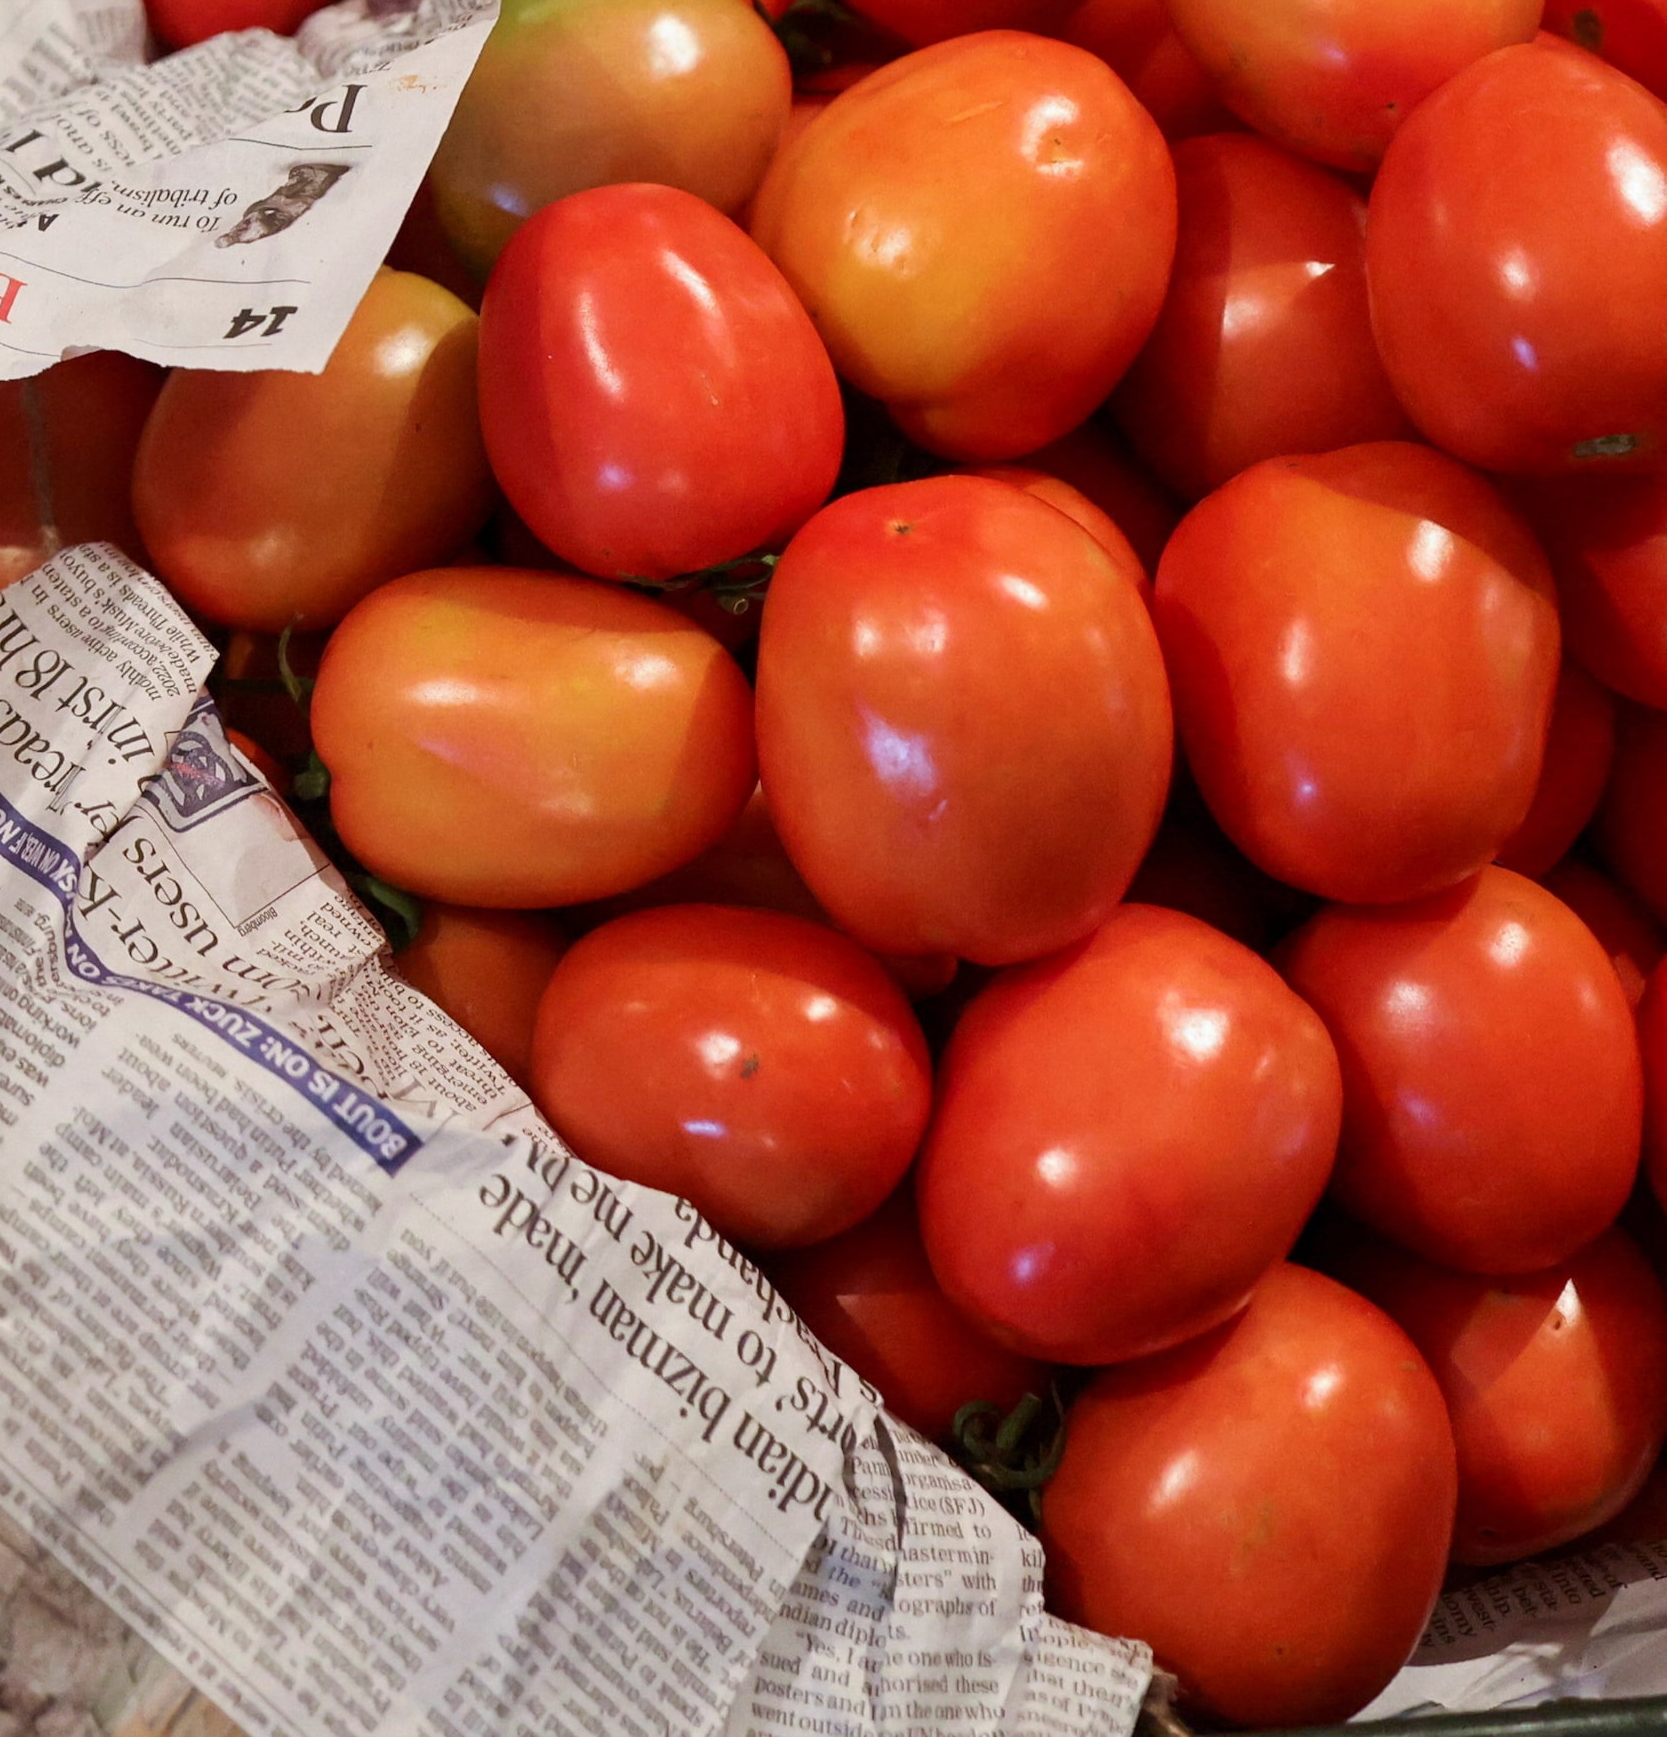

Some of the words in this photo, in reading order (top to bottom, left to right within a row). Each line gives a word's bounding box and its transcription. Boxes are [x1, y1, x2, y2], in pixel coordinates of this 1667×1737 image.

[108, 180, 210, 209] tribalism.
[116, 203, 146, 218] an
[213, 187, 238, 209] of
[151, 214, 191, 228] run
[195, 215, 220, 232] To
[223, 304, 299, 340] 14
[14, 649, 76, 701] 18
[122, 838, 219, 957] users
[236, 901, 279, 938] Bloomberg
[59, 943, 101, 988] ON
[17, 984, 81, 1049] working
[186, 997, 263, 1048] ZUCK
[259, 1036, 310, 1077] ON:
[308, 1071, 340, 1102] IS
[427, 1068, 477, 1112] about
[449, 1059, 498, 1104] threat
[332, 1093, 407, 1159] BOUT
[570, 1171, 634, 1243] me
[630, 1230, 734, 1341] make
[589, 1277, 732, 1444] bizman
[719, 1324, 788, 1392] to
